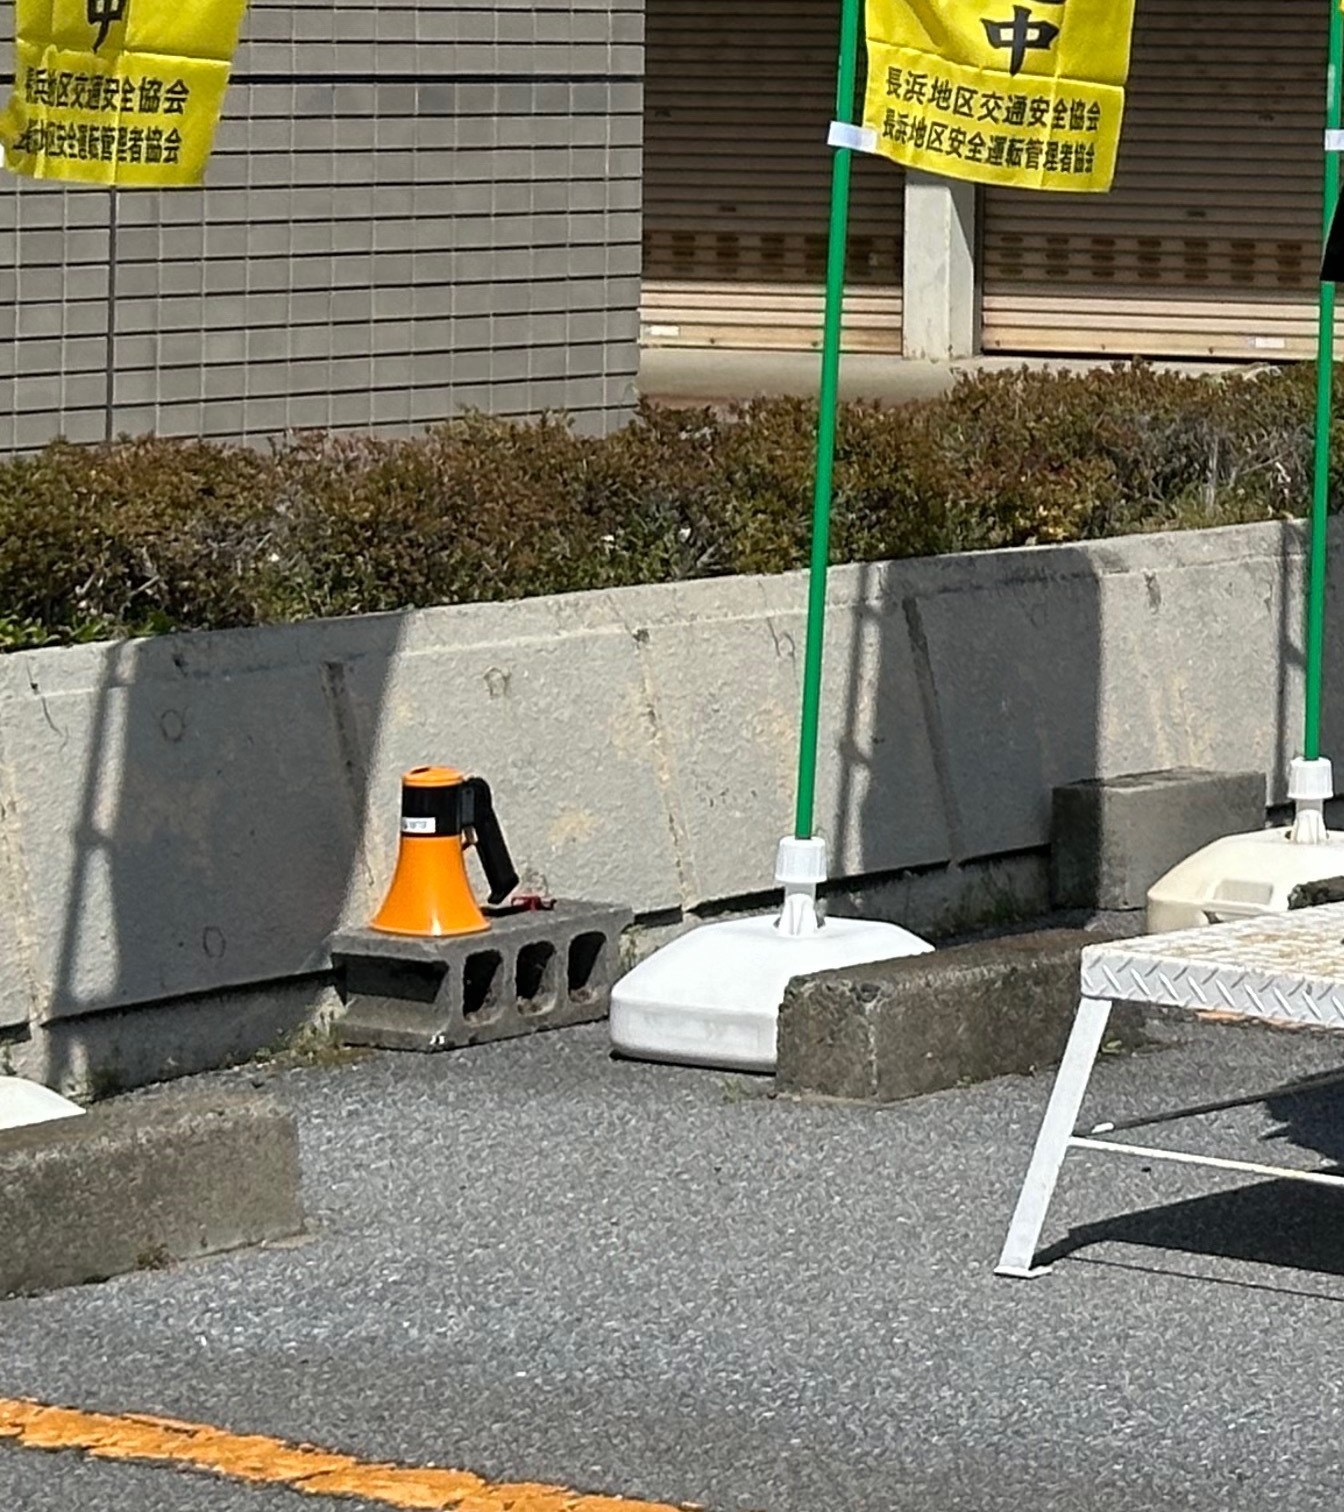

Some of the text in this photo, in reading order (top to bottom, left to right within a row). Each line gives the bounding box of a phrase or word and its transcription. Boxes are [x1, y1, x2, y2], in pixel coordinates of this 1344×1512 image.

[885, 65, 1101, 132] 長浜地区交通安全協会
[881, 108, 1096, 174] 長浜地区安全運転管理者協会
